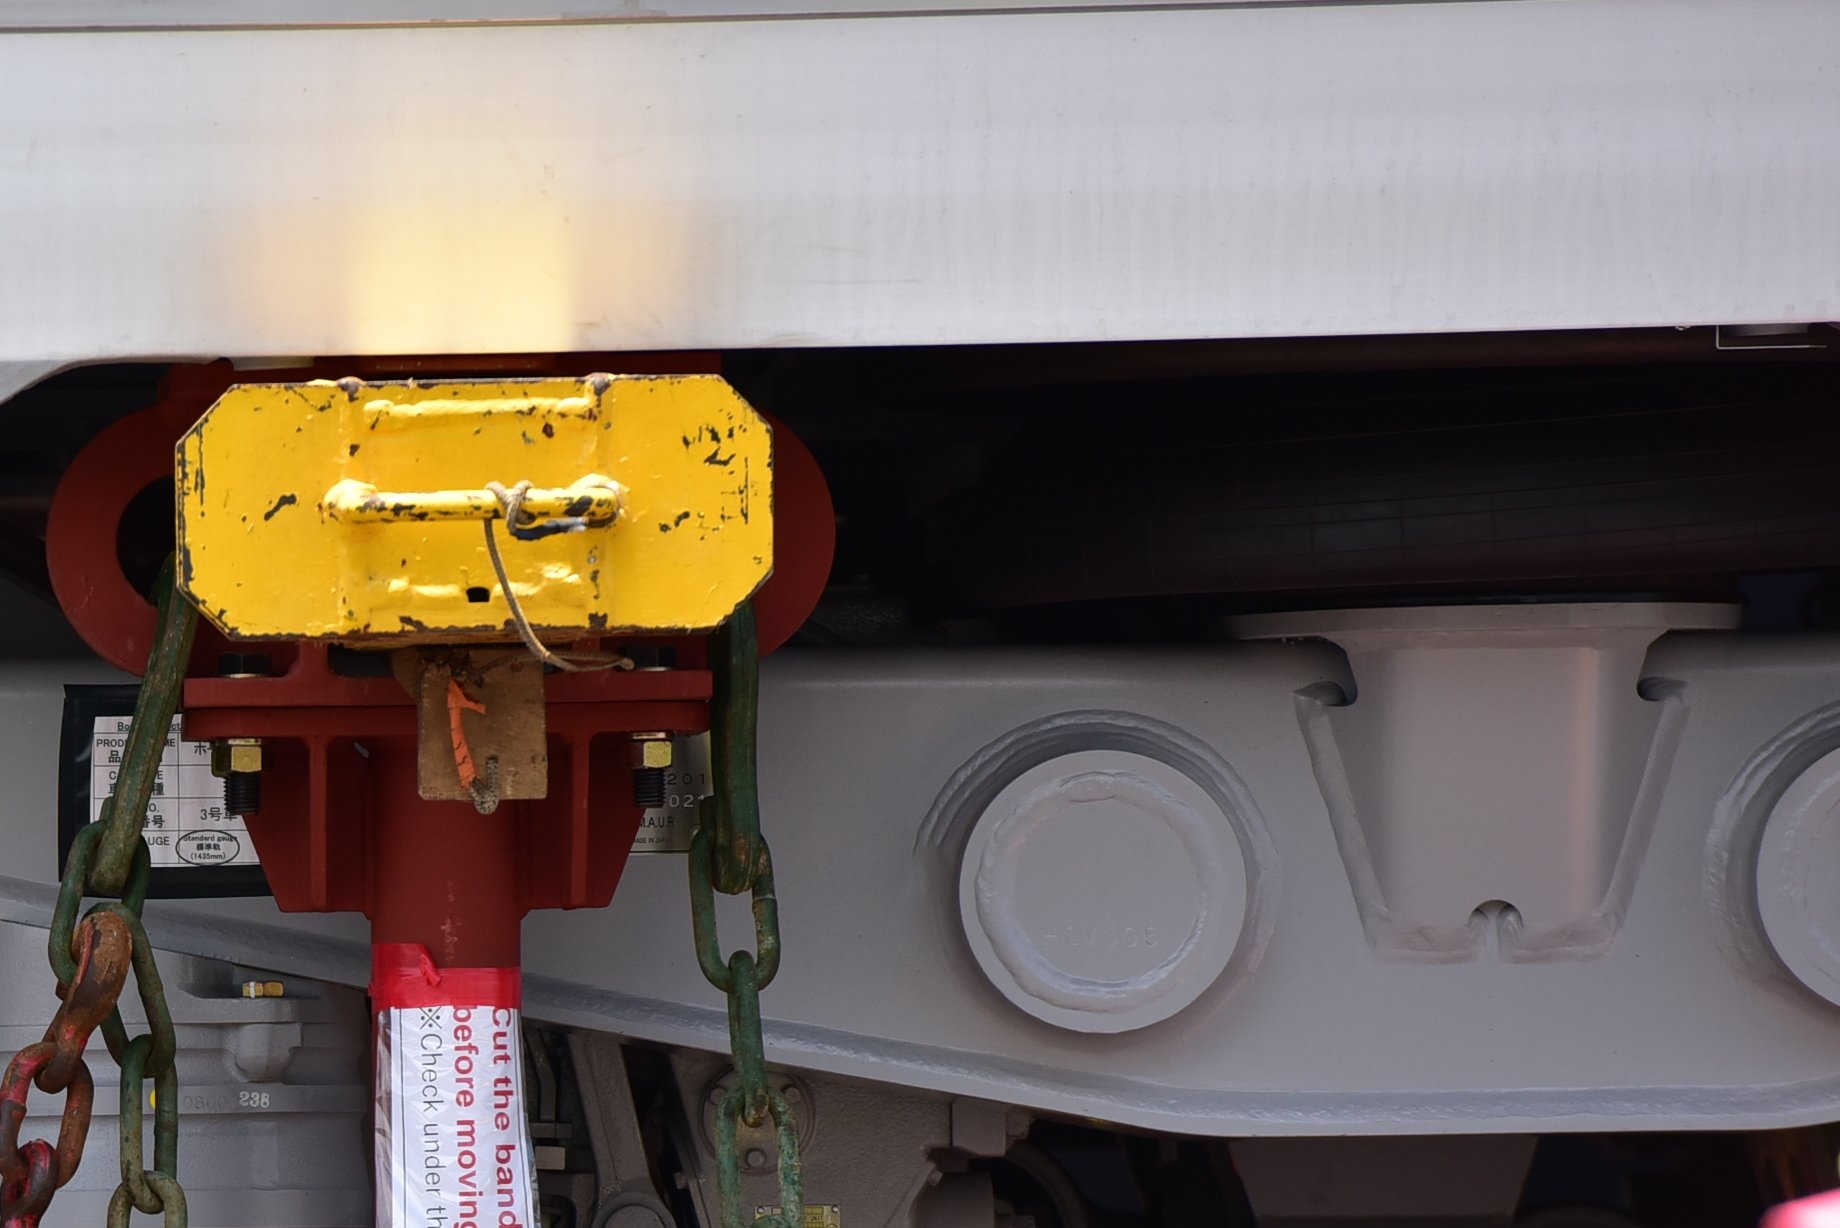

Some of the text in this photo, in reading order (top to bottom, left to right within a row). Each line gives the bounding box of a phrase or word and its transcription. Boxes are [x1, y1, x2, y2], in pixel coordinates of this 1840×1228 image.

[190, 852, 226, 861] (1435mm)
[452, 1006, 480, 1108] before
[491, 1007, 512, 1065] Cut
[239, 1090, 271, 1109] 238
[493, 1076, 514, 1131] the
[423, 1123, 447, 1197] under
